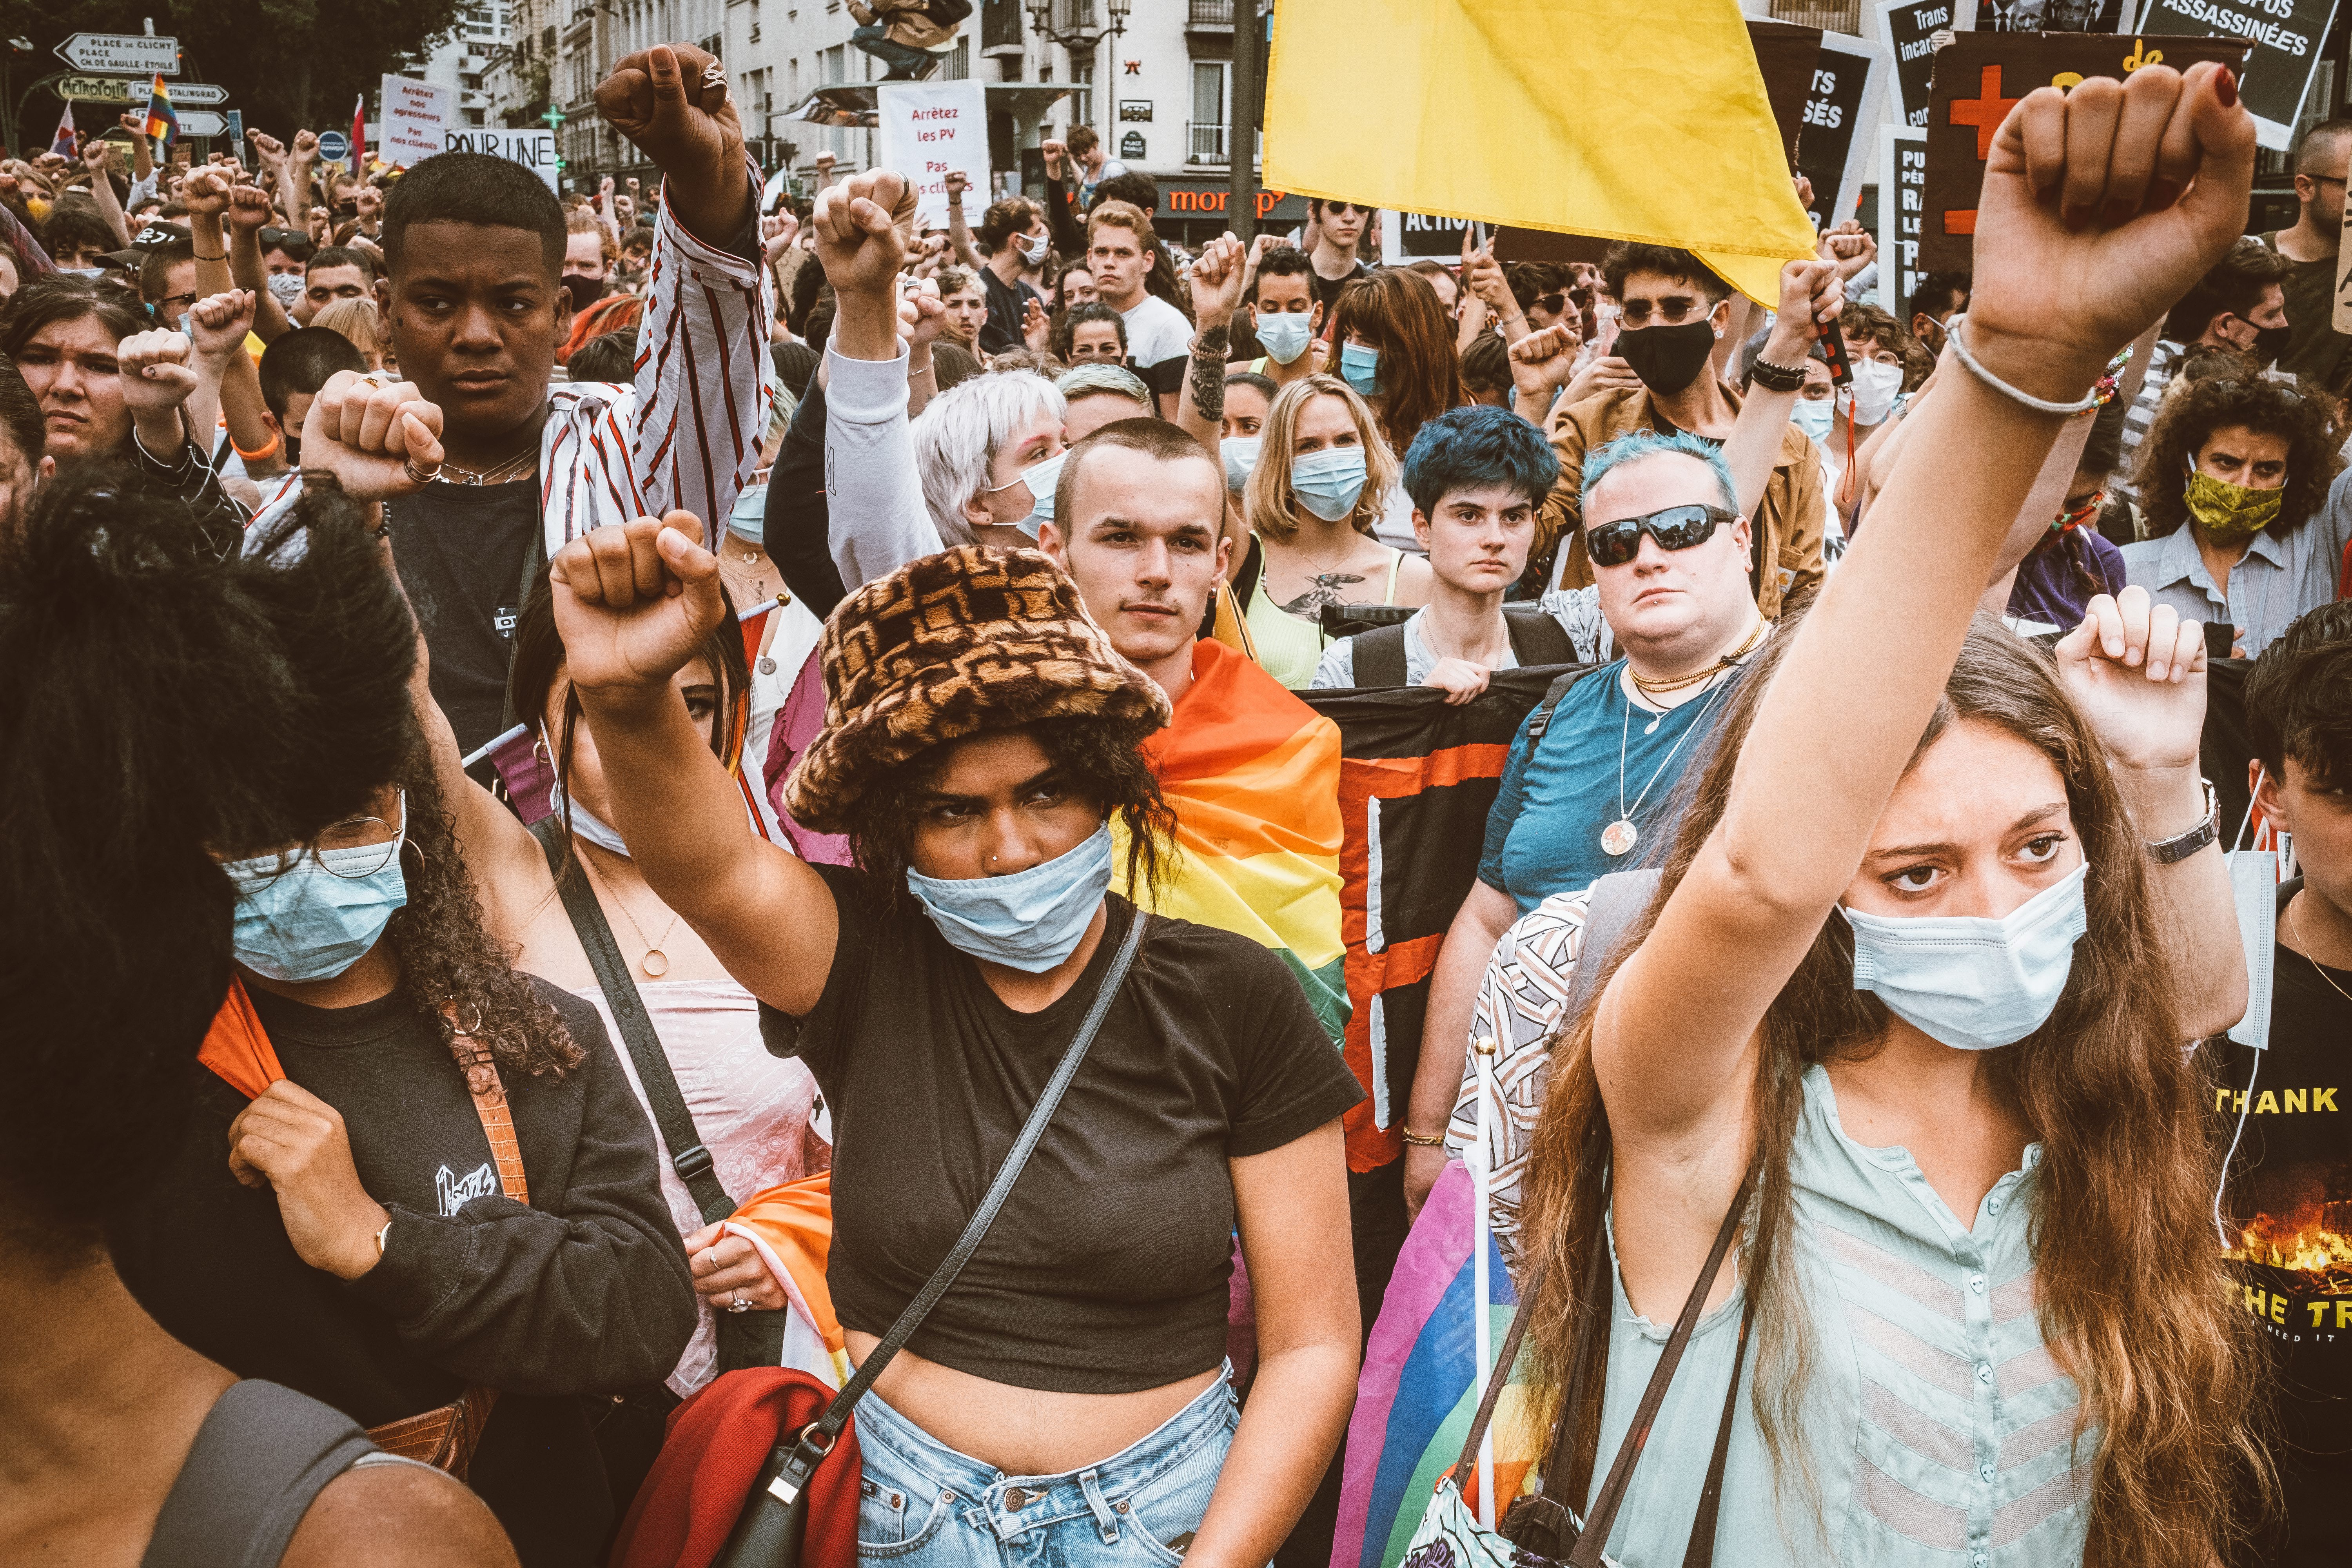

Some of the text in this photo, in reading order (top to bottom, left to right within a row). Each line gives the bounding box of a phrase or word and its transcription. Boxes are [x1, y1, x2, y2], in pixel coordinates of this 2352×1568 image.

[1913, 6, 1948, 30] Trans
[2162, 0, 2308, 56] ASSASSINÉES
[91, 39, 121, 48] PLACE
[137, 41, 172, 50] CLICHY
[402, 87, 434, 98] Arrêtez
[394, 108, 441, 122] agresseurs
[912, 107, 958, 121] Arrêtez
[407, 127, 422, 136] Pas
[917, 128, 956, 142] les PV
[391, 136, 437, 150] nos clients
[445, 133, 553, 167] POUR UNE
[926, 161, 947, 172] Pas
[2216, 1088, 2339, 1114] THANK
[2267, 1325, 2301, 1342] NEED
[2316, 1334, 2335, 1342] IT
